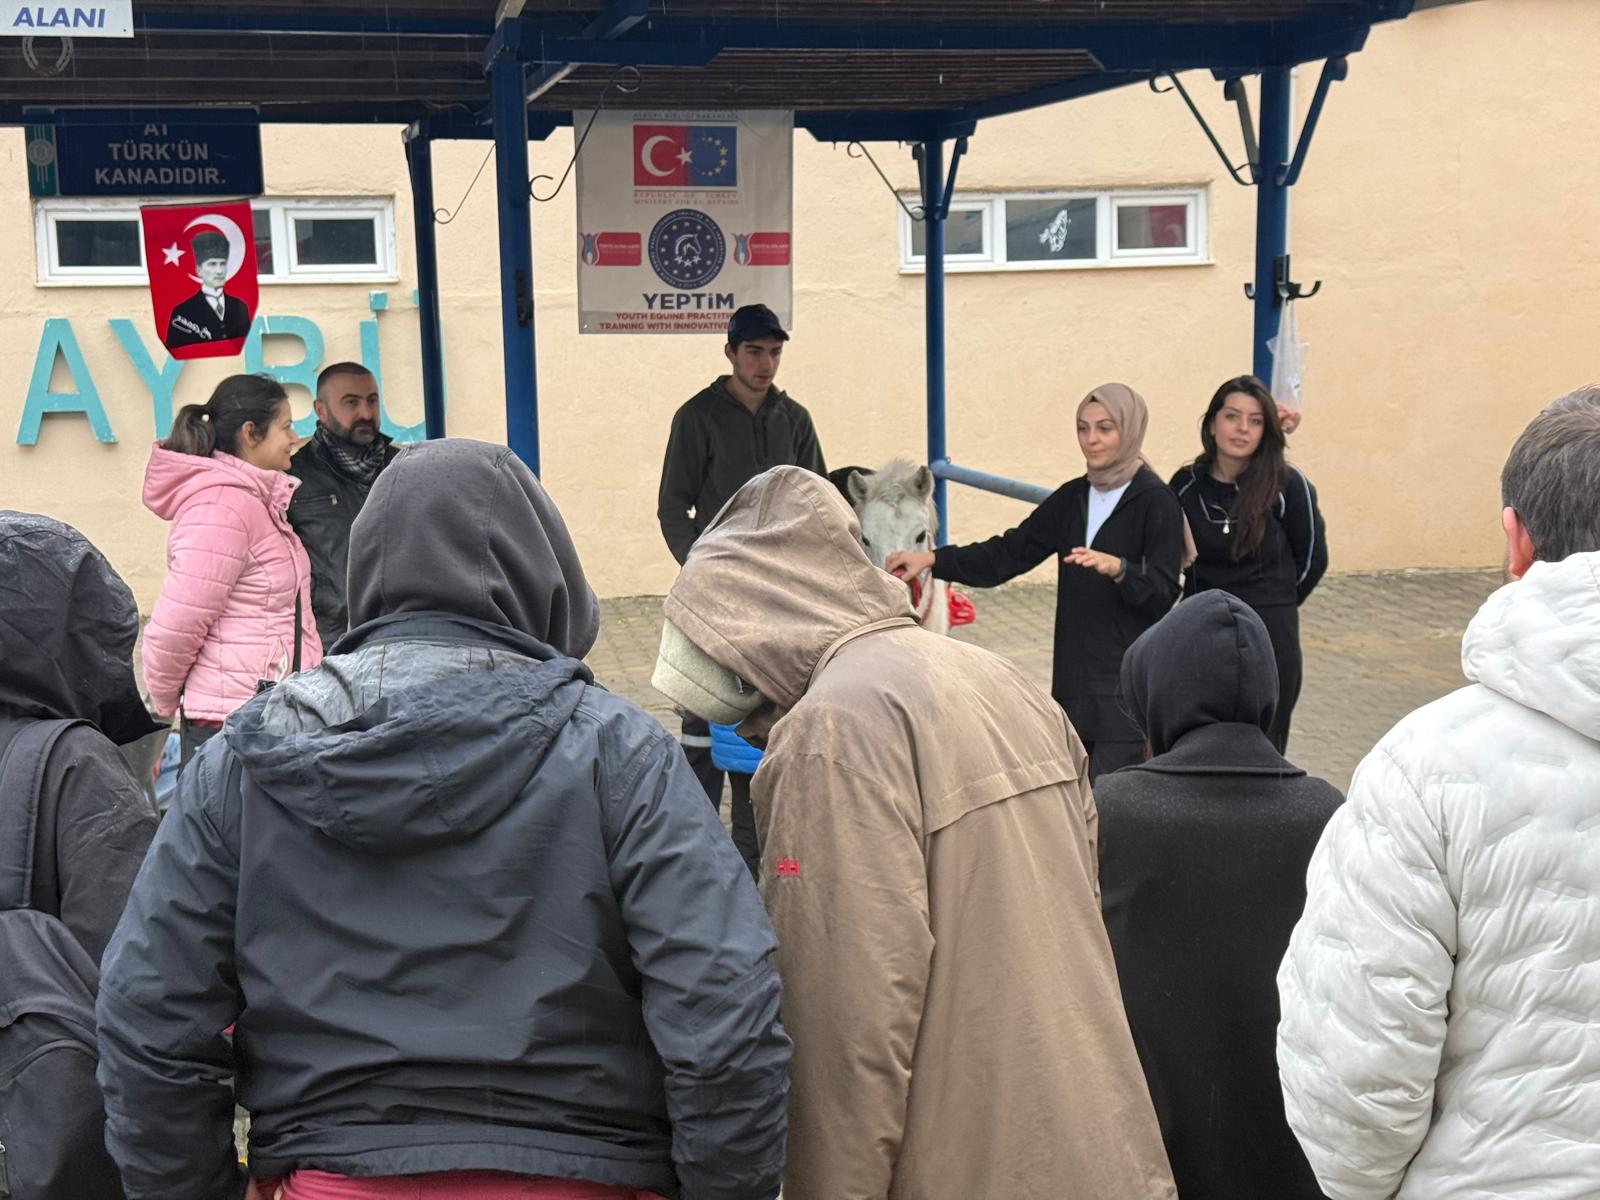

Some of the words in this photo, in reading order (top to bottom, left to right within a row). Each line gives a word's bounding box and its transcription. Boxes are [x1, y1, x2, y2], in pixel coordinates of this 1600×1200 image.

[12, 7, 106, 28] ALANI
[108, 139, 209, 161] TÜRK'ÜN
[95, 167, 227, 185] KANADIDIR.
[616, 312, 648, 320] YOUTH
[650, 312, 685, 320] EQUINE
[599, 322, 645, 330] TRAINING
[647, 322, 672, 330] WITH
